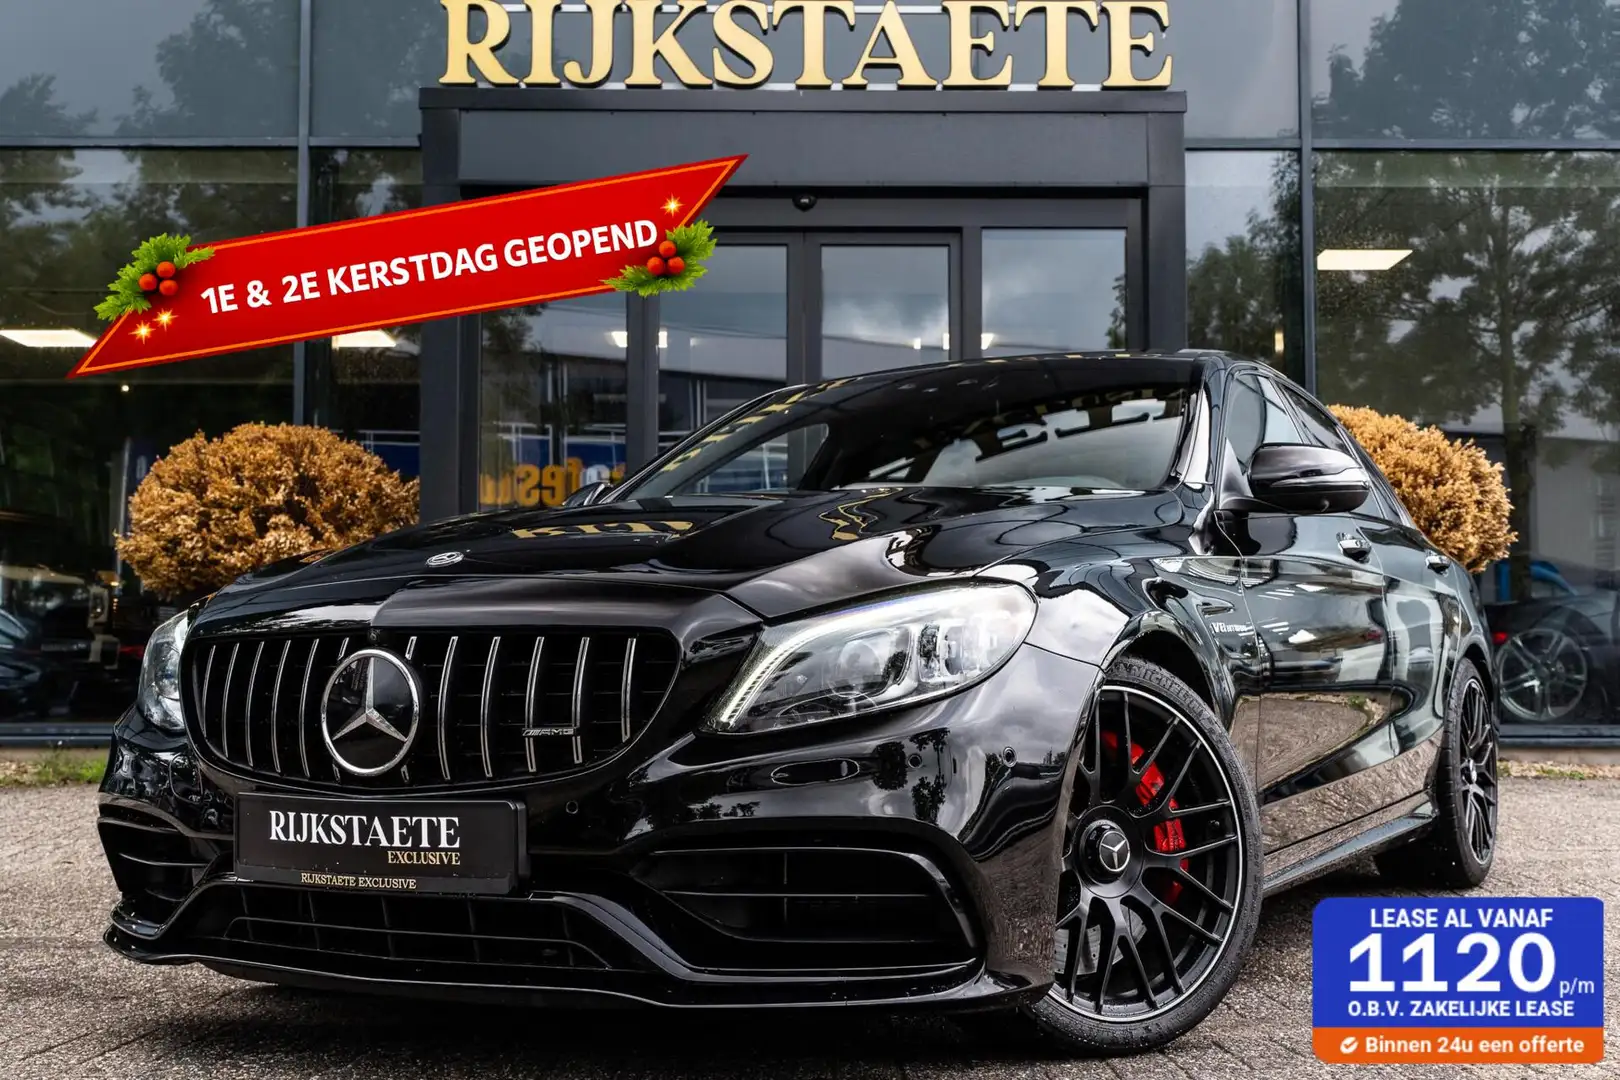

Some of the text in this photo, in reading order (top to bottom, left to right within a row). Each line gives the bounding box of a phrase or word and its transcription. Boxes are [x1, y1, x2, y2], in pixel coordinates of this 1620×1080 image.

[438, 0, 1173, 89] RIJKSTAETE
[269, 810, 461, 848] RIJKSTAETE
[387, 850, 461, 866] EXCLUSIVE
[300, 872, 417, 890] RIJKSTAETE EXCLUSIVE
